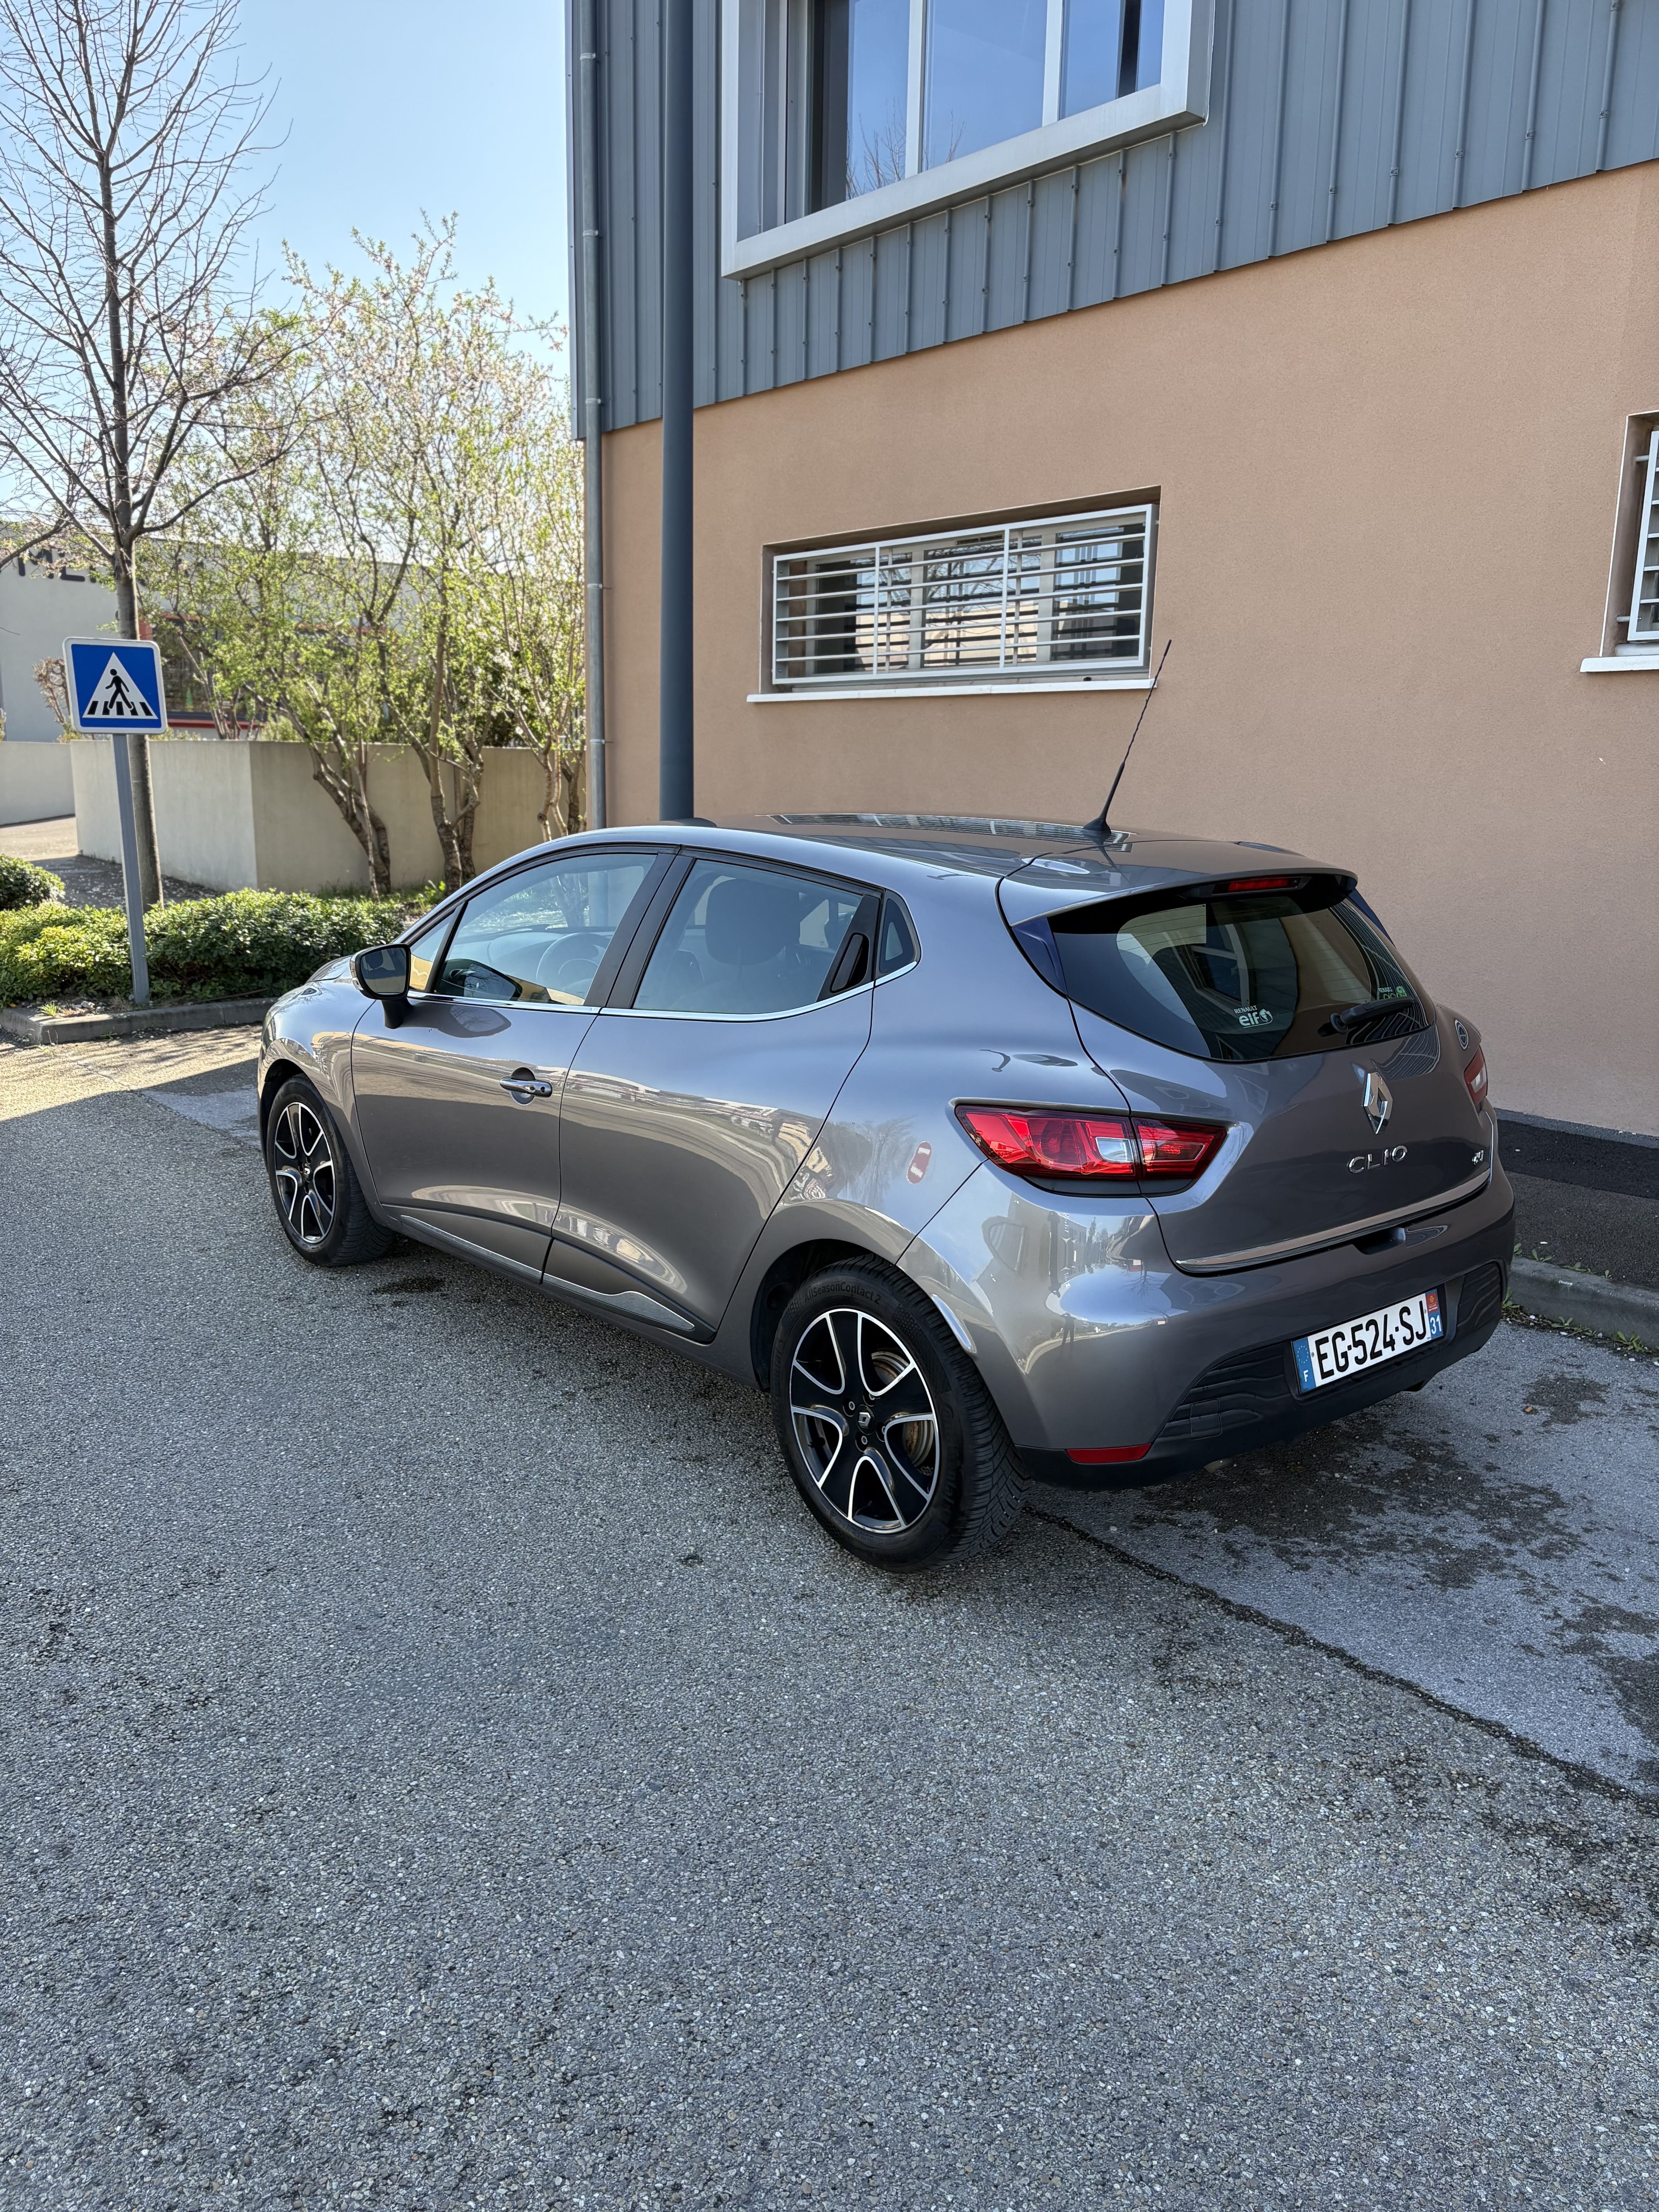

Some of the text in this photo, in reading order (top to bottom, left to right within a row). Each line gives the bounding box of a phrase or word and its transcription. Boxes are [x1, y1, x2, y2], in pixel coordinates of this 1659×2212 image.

[1234, 1005, 1257, 1014] RENAULT
[1239, 1012, 1260, 1026] elf
[1348, 1145, 1408, 1173] CLIO
[874, 1295, 881, 1305] 2
[1430, 1315, 1442, 1334] 31
[1304, 1369, 1309, 1382] F
